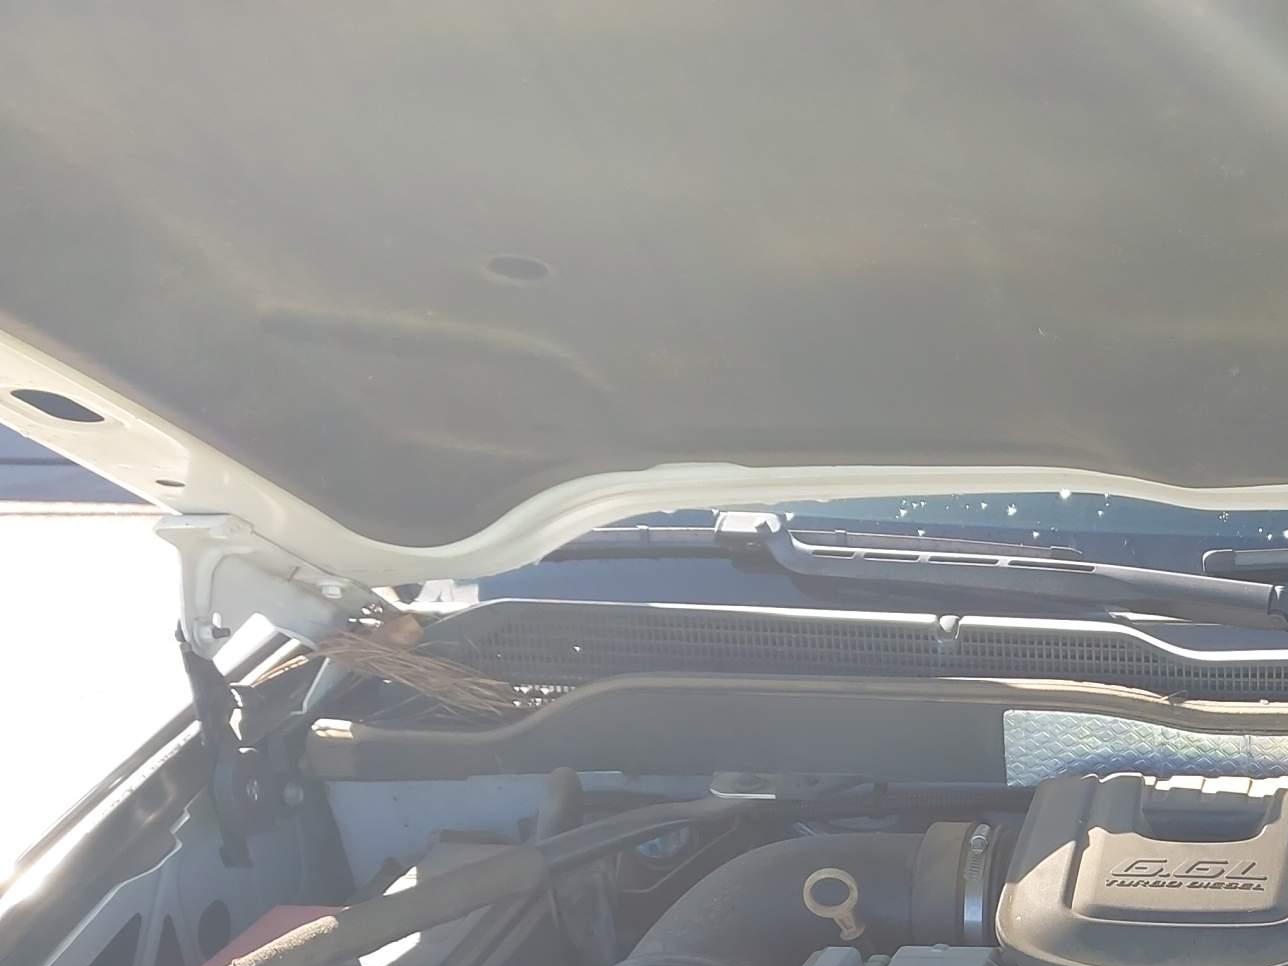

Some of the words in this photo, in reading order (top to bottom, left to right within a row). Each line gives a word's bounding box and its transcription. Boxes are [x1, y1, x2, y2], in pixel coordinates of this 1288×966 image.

[1111, 859, 1267, 881] 6.6L
[1105, 879, 1182, 888] TURBO
[1186, 881, 1265, 891] DIESEL
